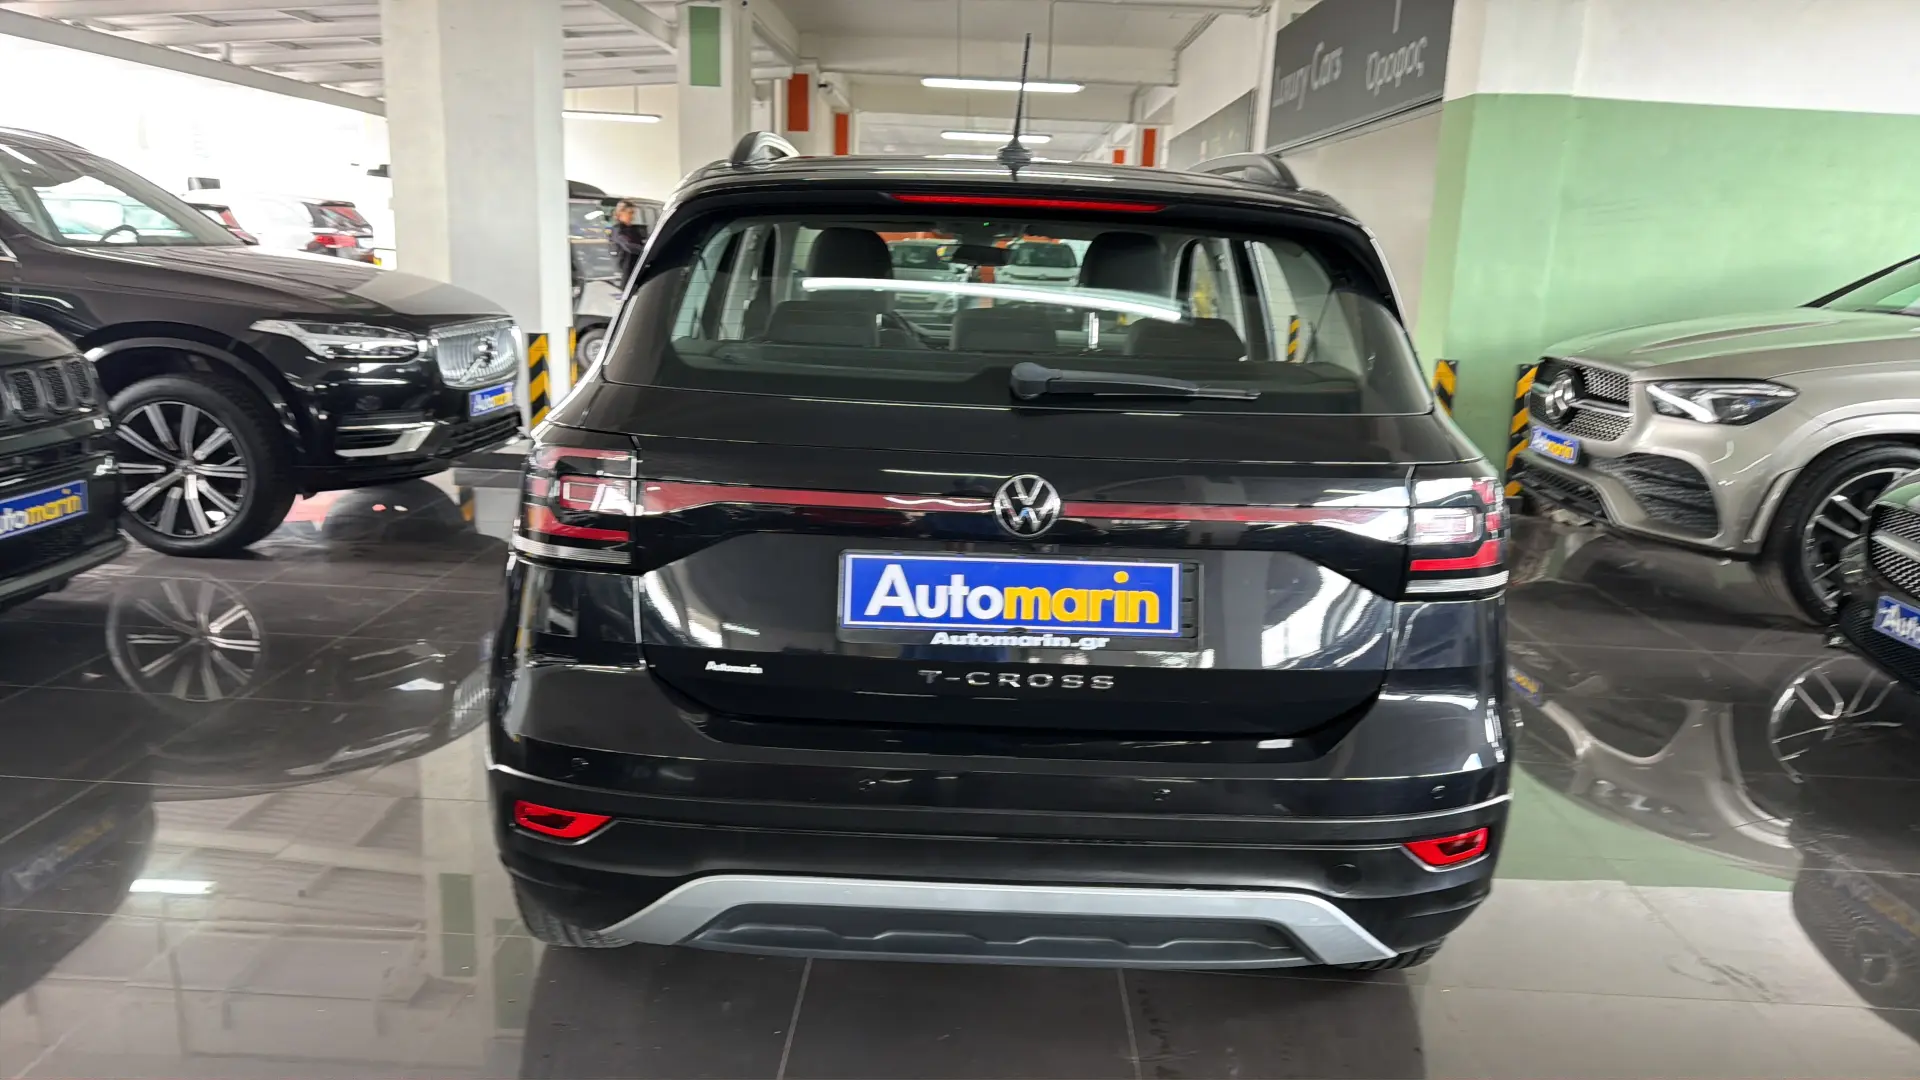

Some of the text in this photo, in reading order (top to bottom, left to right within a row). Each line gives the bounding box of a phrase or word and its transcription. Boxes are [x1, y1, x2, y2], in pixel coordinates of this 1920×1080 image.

[1311, 41, 1343, 91] Cars
[864, 564, 1160, 624] Automarin
[930, 631, 1111, 650] Automarin.gr
[917, 669, 1115, 689] T-CROSS
